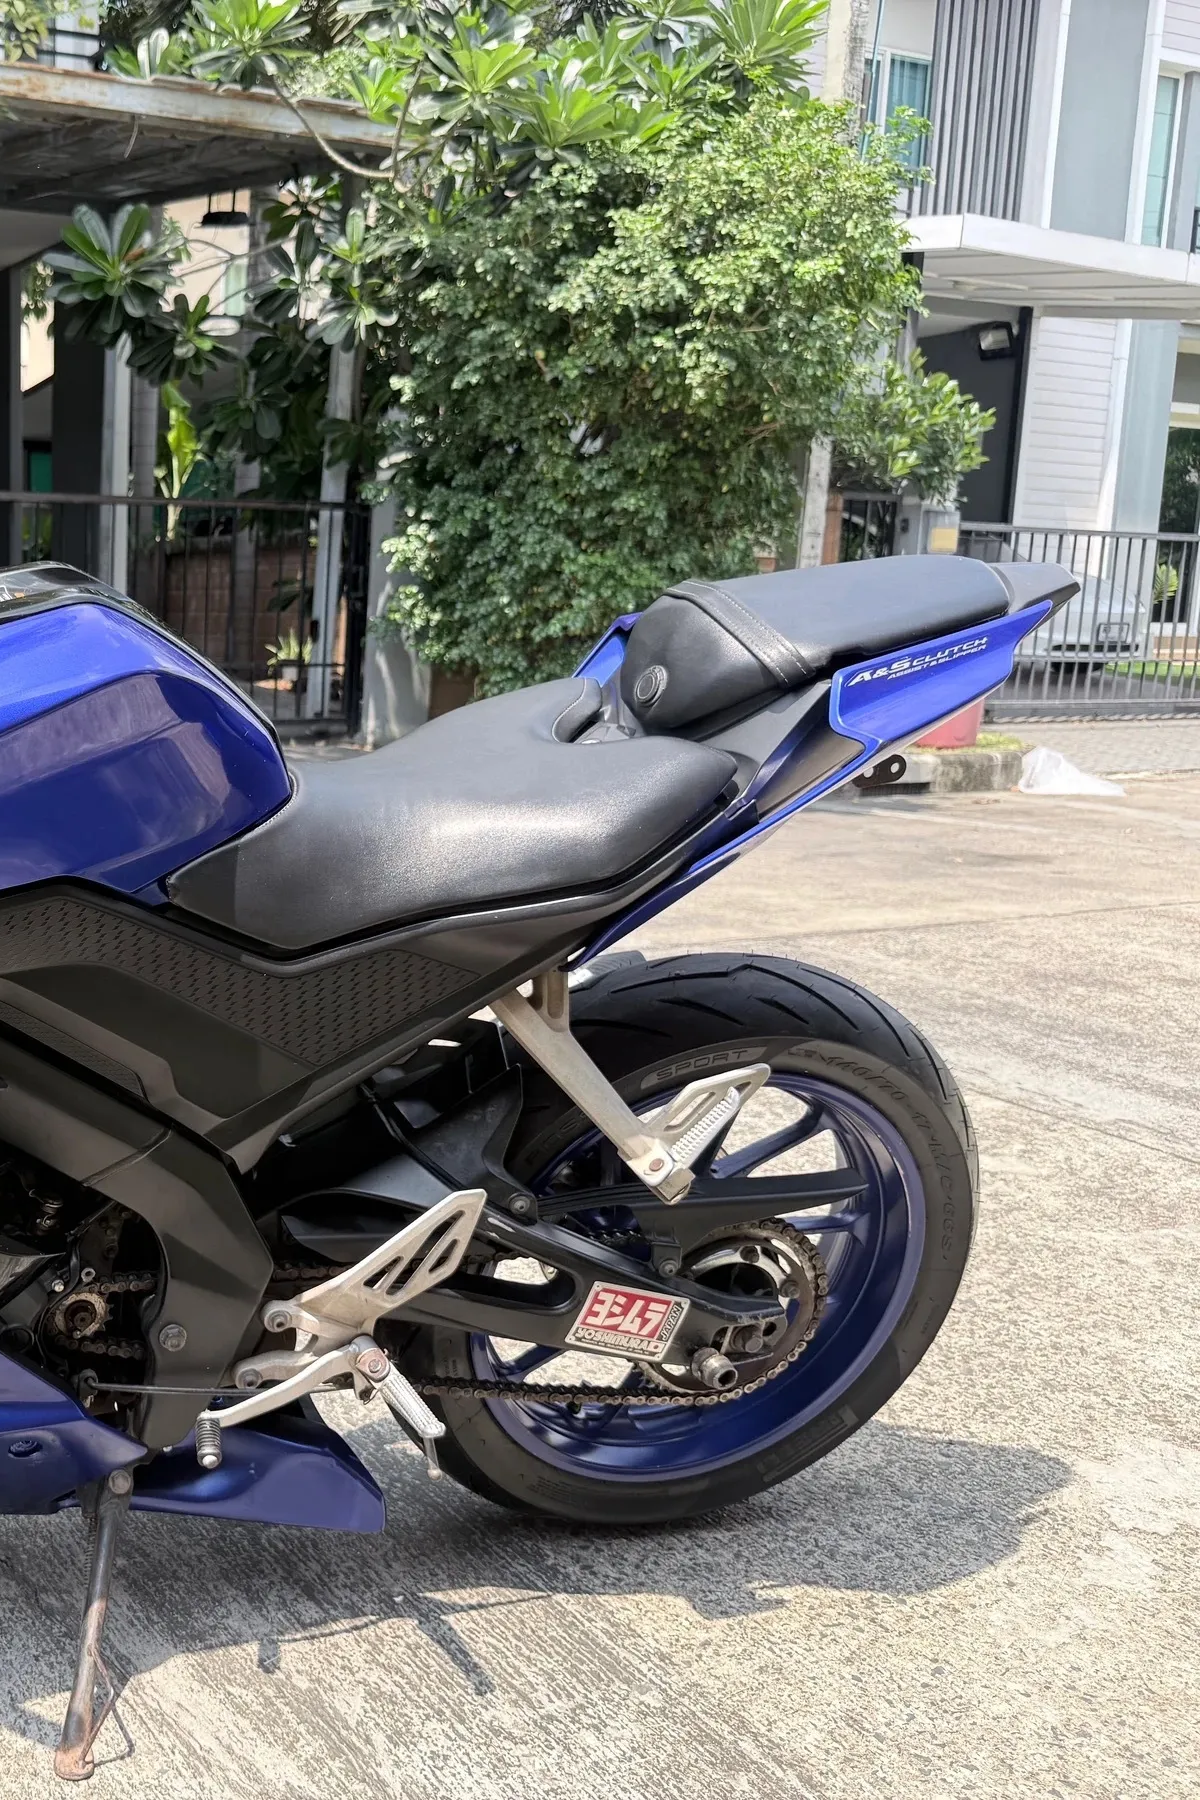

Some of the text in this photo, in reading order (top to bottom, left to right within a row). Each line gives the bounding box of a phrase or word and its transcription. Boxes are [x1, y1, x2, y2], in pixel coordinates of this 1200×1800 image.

[847, 636, 988, 687] A&S CLUTCH
[655, 1050, 750, 1082] SPORT
[585, 1291, 668, 1335] ヨシムラ
[661, 1304, 682, 1342] JAPAN
[575, 1327, 651, 1351] YOSHIMURA
